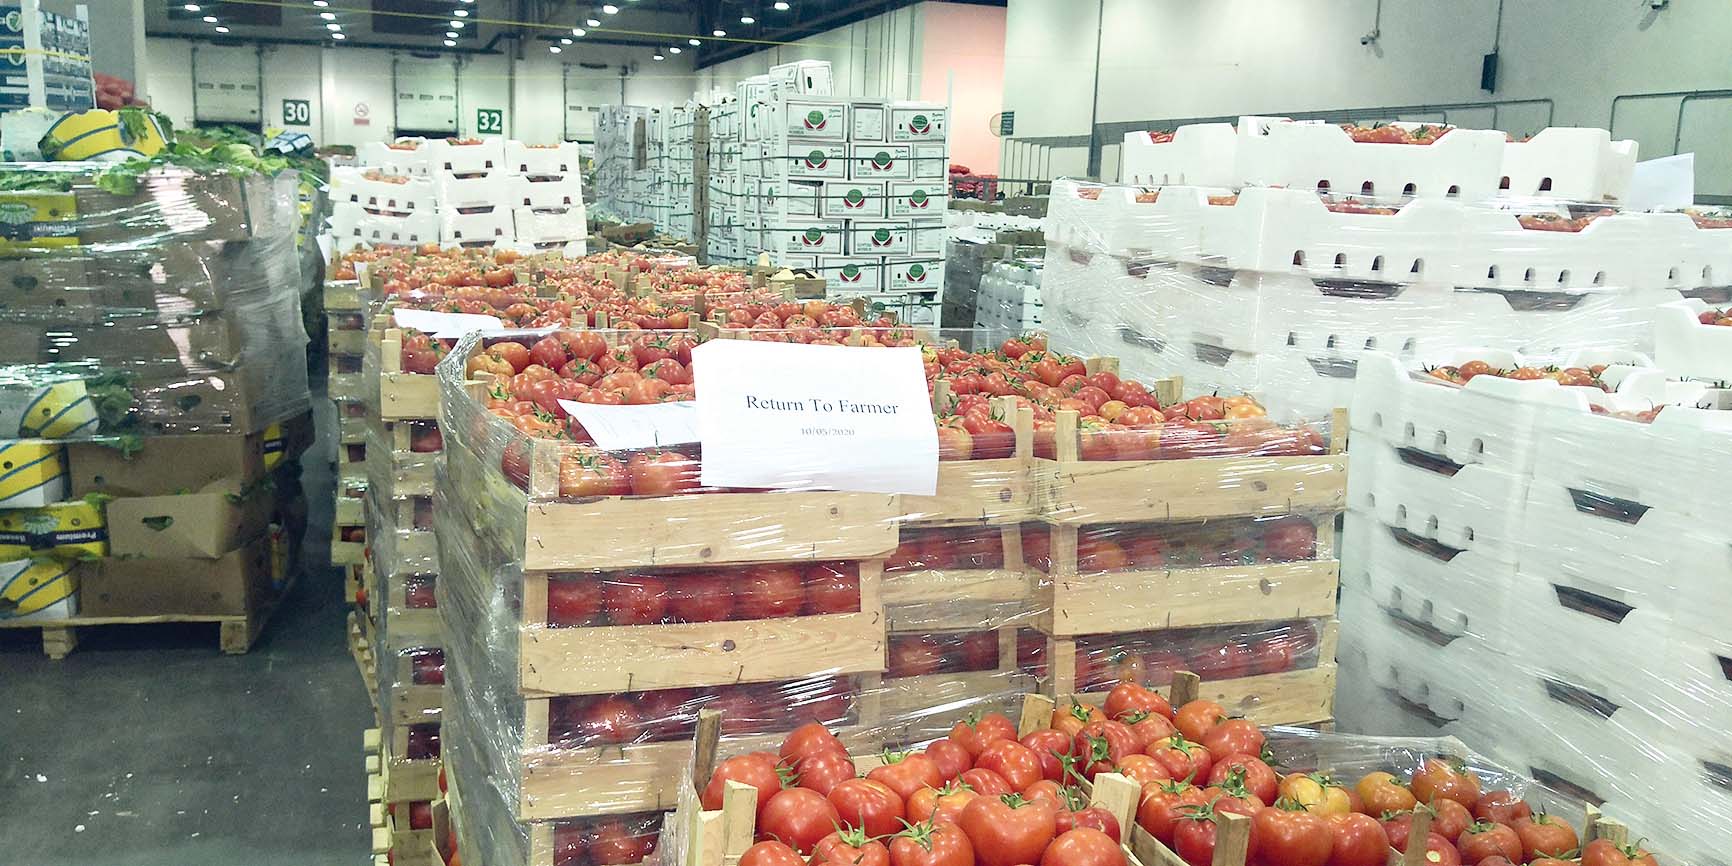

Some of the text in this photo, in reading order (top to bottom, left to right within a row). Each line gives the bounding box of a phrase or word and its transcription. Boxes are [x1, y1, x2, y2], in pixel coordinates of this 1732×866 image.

[285, 102, 308, 122] 30
[479, 112, 501, 130] 32
[746, 395, 899, 414] Return To Farmer
[801, 427, 855, 436] 10/05/2020
